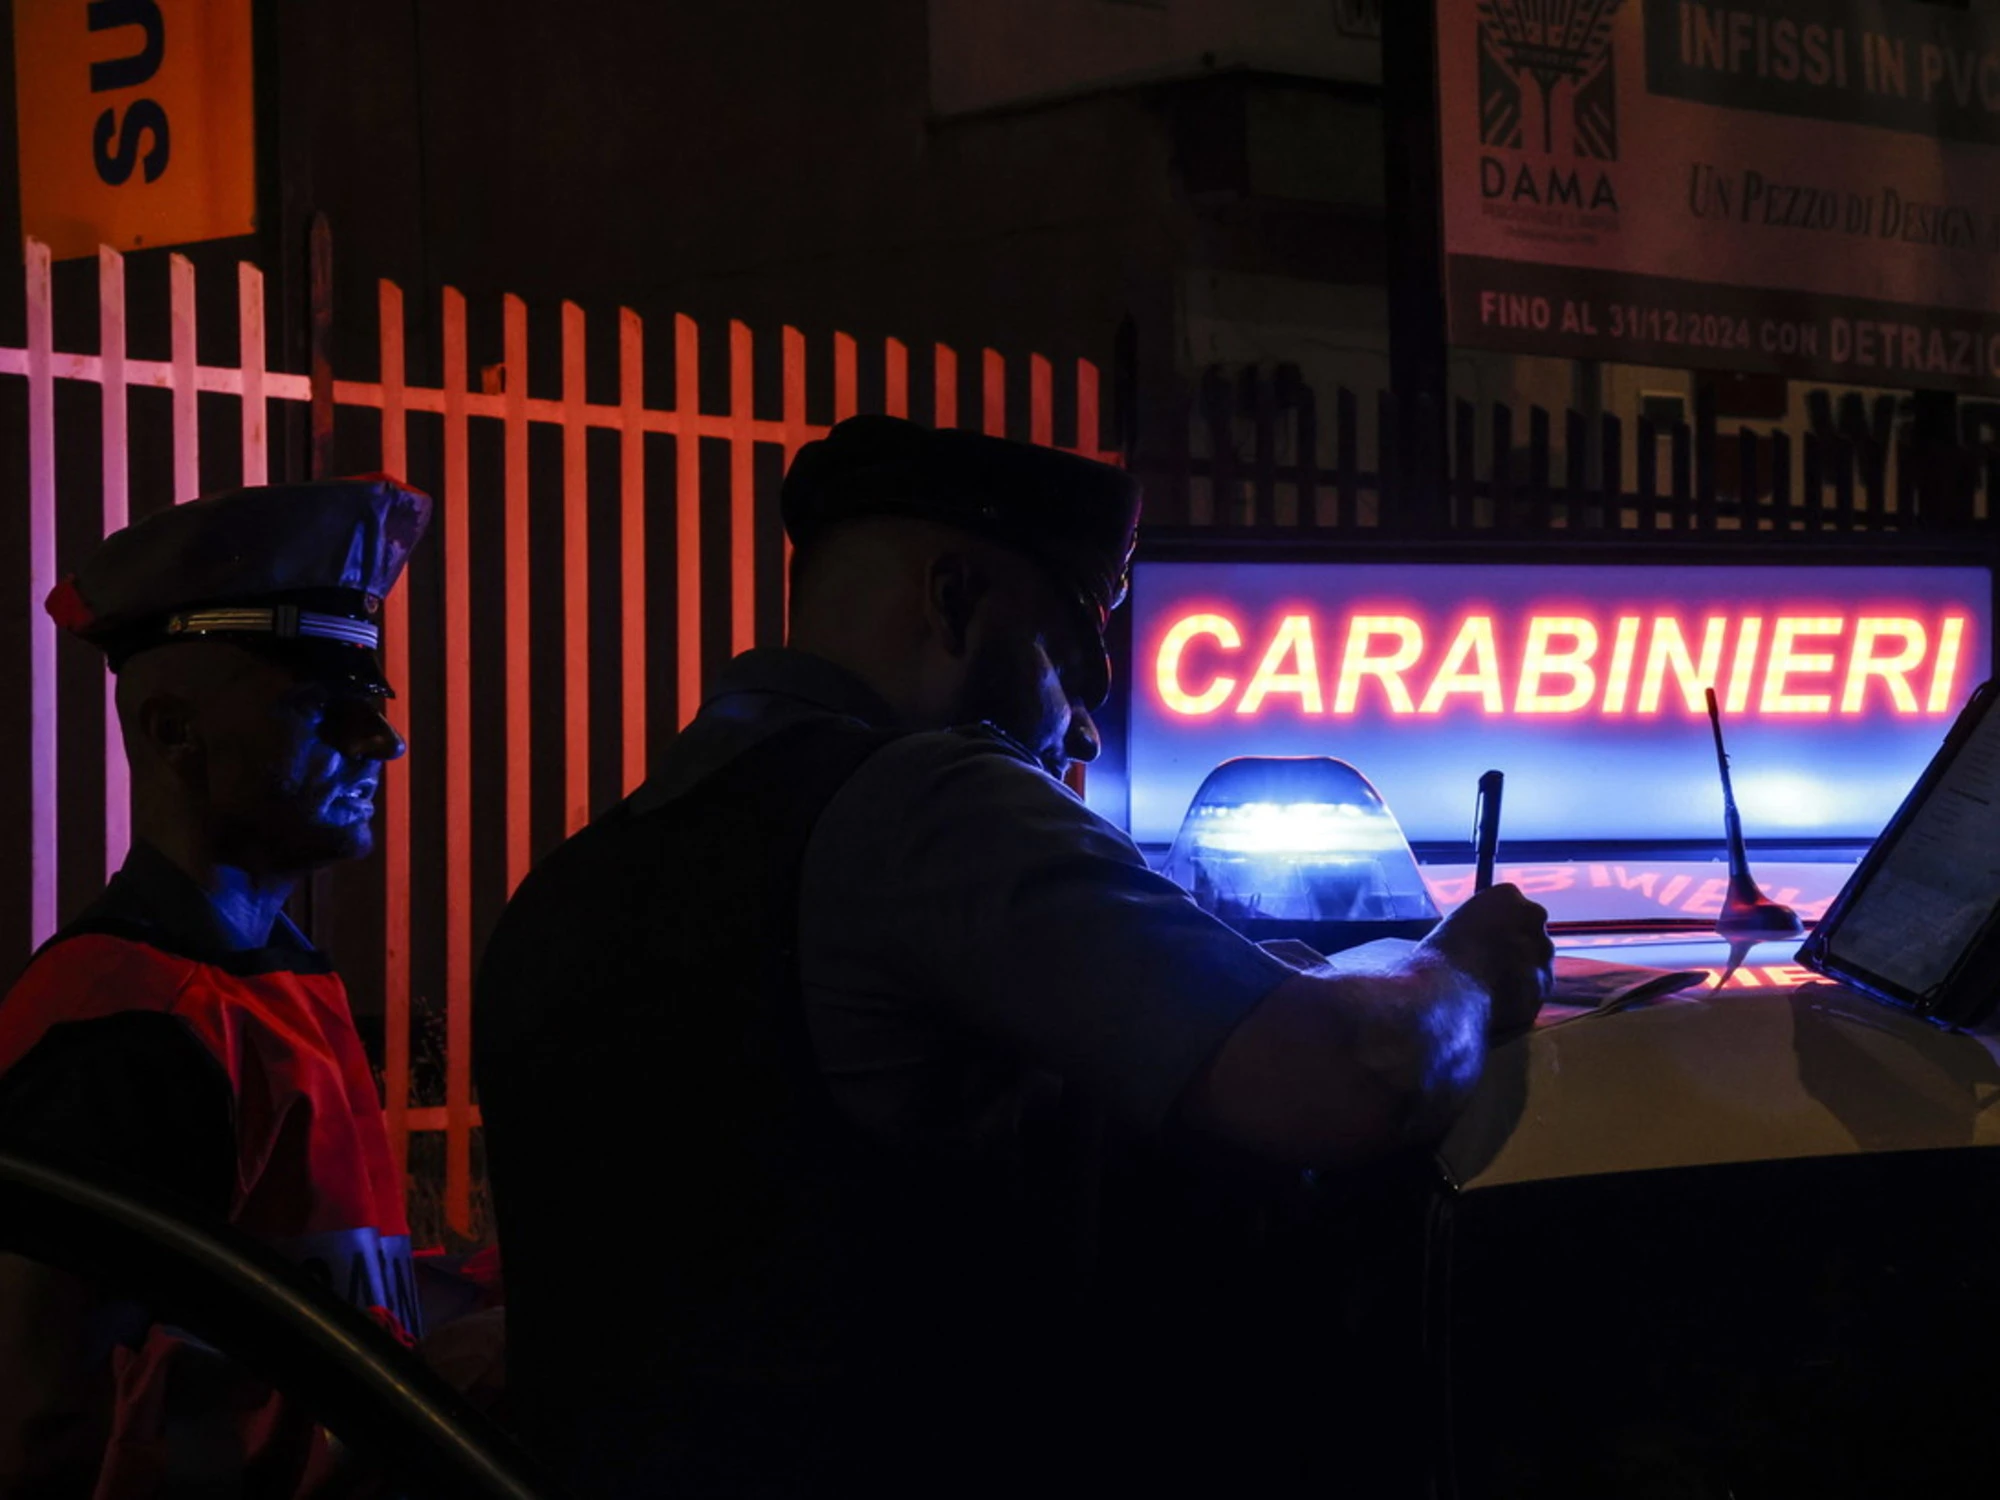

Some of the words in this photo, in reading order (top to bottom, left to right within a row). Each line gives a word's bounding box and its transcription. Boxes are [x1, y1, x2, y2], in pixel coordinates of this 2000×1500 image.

[1679, 0, 1848, 89] INFISSI
[1863, 31, 1908, 99] IN
[1921, 42, 2000, 113] PVC
[1480, 155, 1619, 213] DAMA
[1480, 290, 1551, 331] FINO
[1560, 300, 1598, 335] AL
[1608, 304, 1752, 350] 31/12/2024
[1760, 318, 1818, 356] CON
[1156, 613, 1964, 716] CARABINIERI
